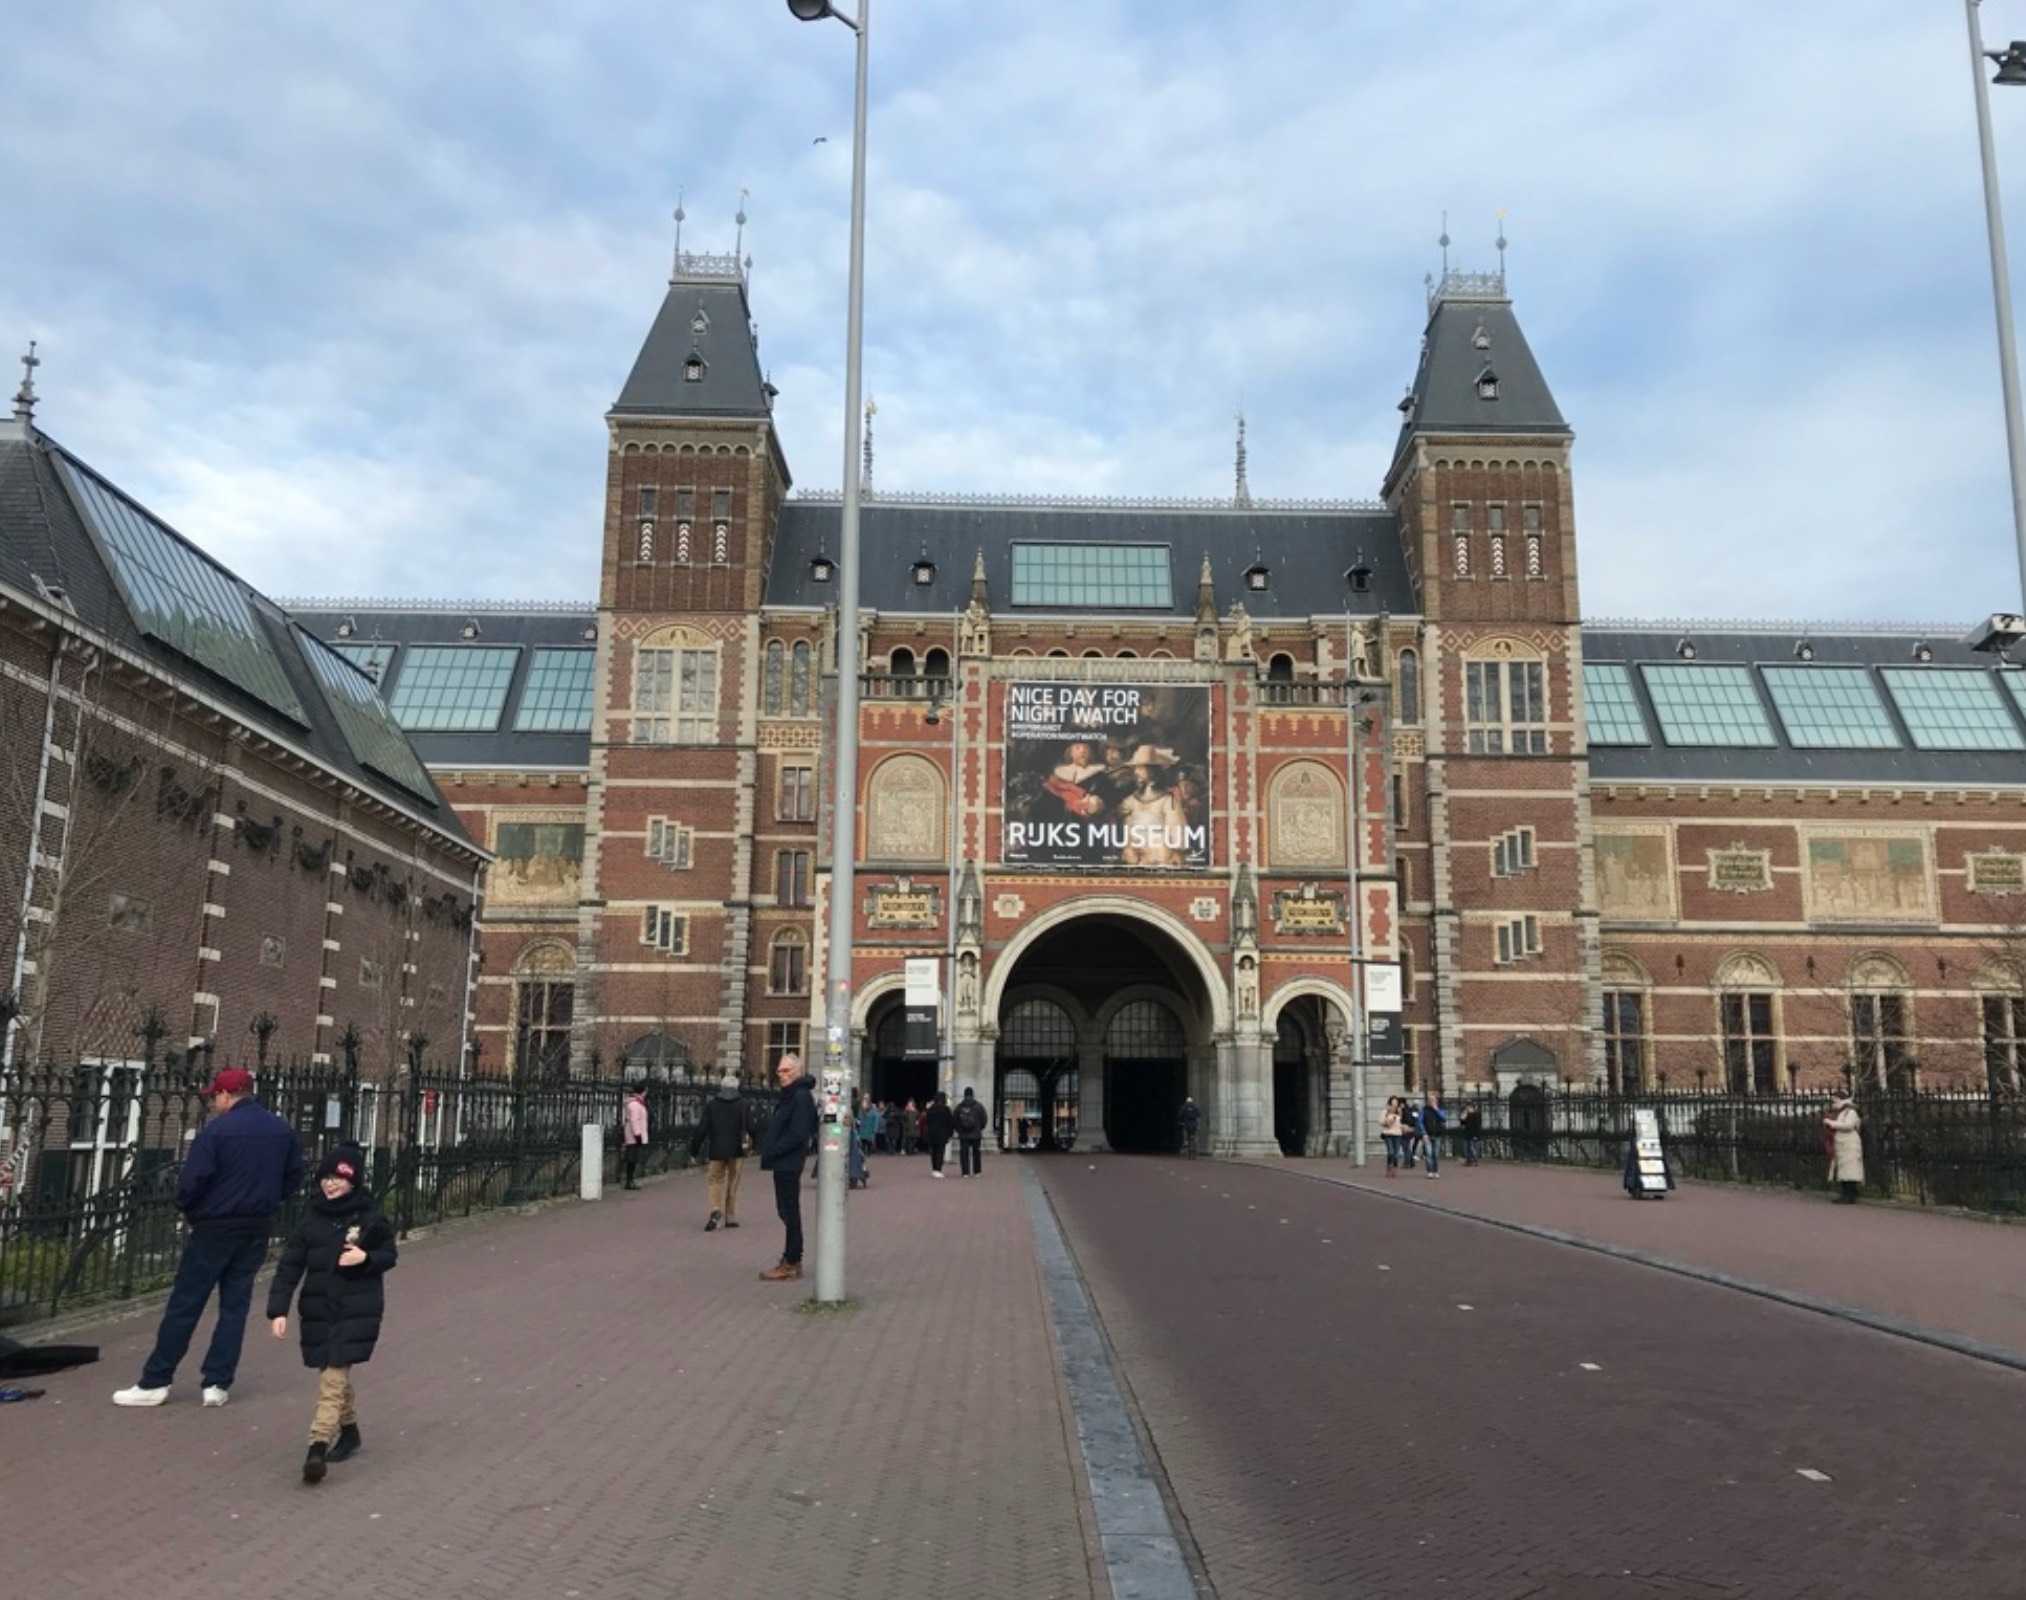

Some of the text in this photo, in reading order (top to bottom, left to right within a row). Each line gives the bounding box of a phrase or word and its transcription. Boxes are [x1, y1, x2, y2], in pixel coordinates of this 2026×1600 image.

[1011, 687, 1140, 707] NICE DAY FOR
[1011, 705, 1138, 725] NIGHT WATCH
[1009, 822, 1206, 849] RIJKS MUSEUM
